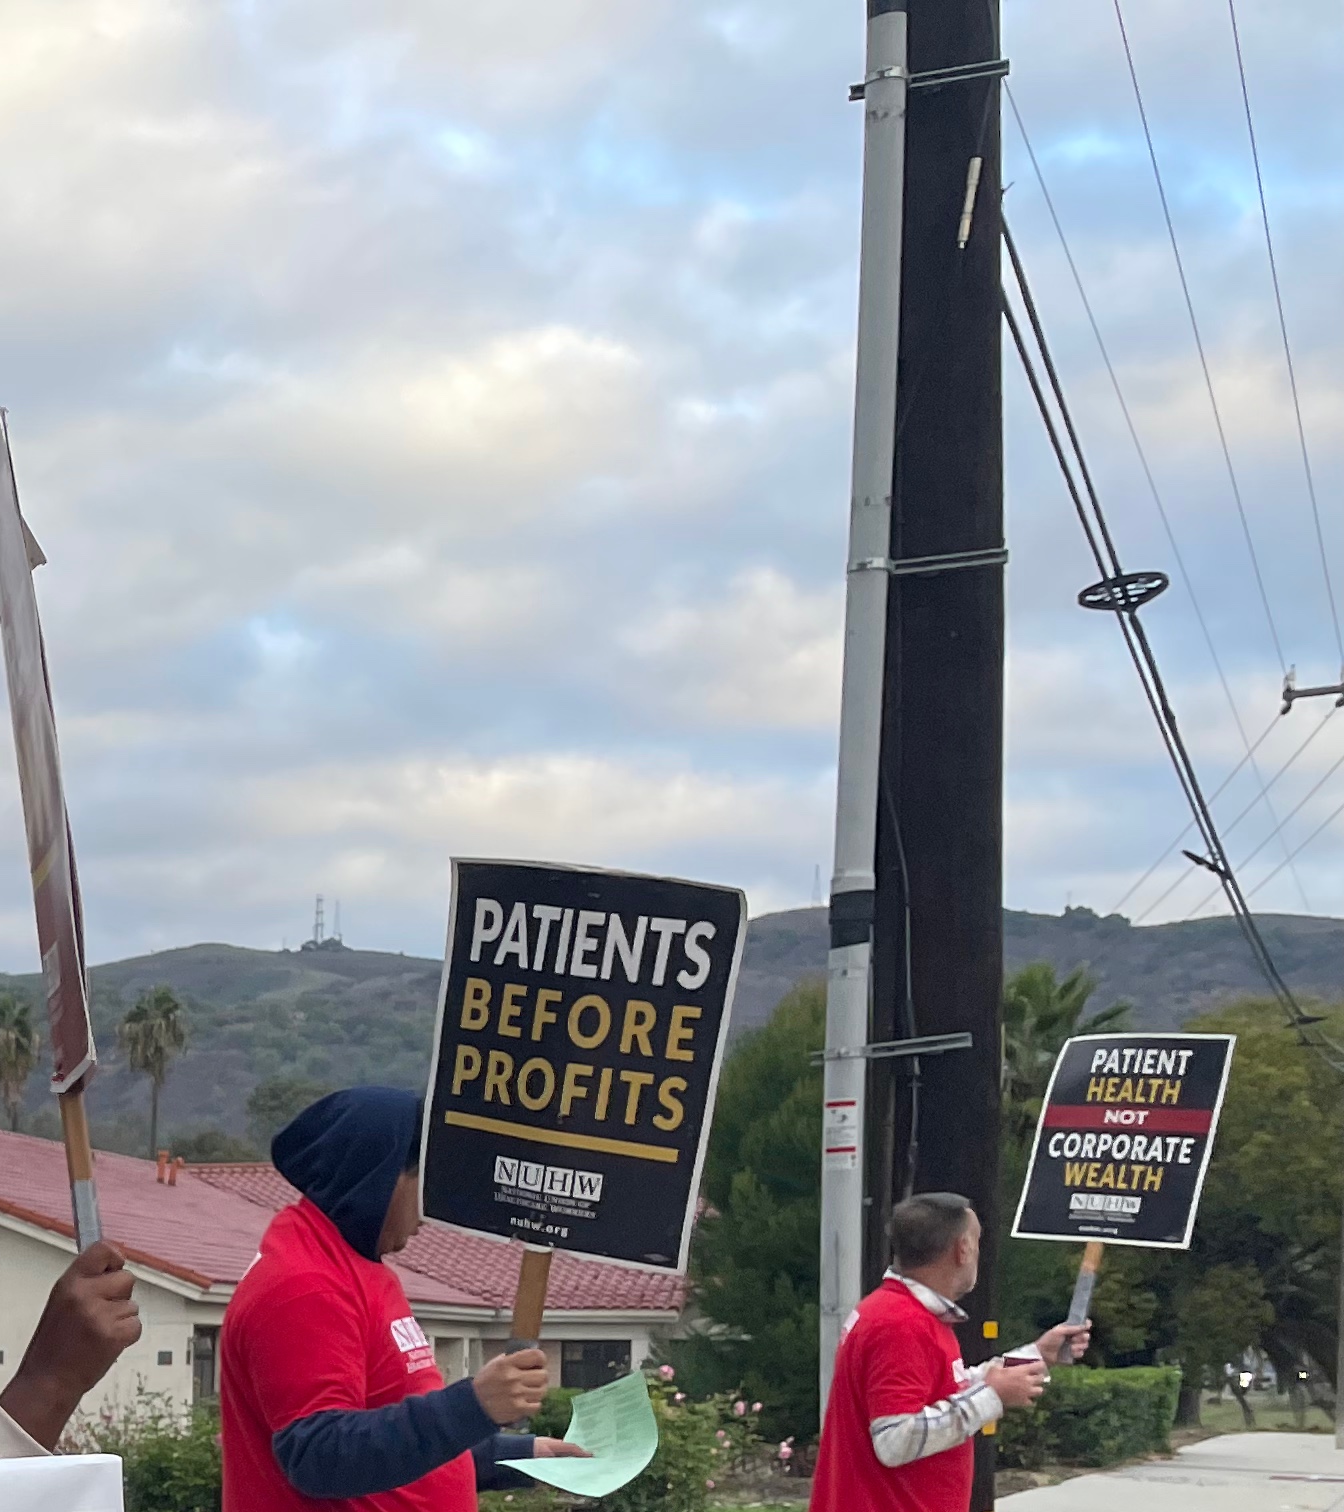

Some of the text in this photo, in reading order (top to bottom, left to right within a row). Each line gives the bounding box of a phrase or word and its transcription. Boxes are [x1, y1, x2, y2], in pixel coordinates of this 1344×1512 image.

[469, 897, 717, 990] PATIENTS
[460, 976, 703, 1062] BEFORE
[1090, 1048, 1194, 1076] PATIENT
[450, 1043, 688, 1132] PROFITS
[1086, 1076, 1182, 1105] HEALTH
[1103, 1109, 1150, 1125] NOT
[1048, 1132, 1196, 1164] CORPORATE
[495, 1157, 602, 1200] NUHW
[1064, 1161, 1164, 1192] WEALTH
